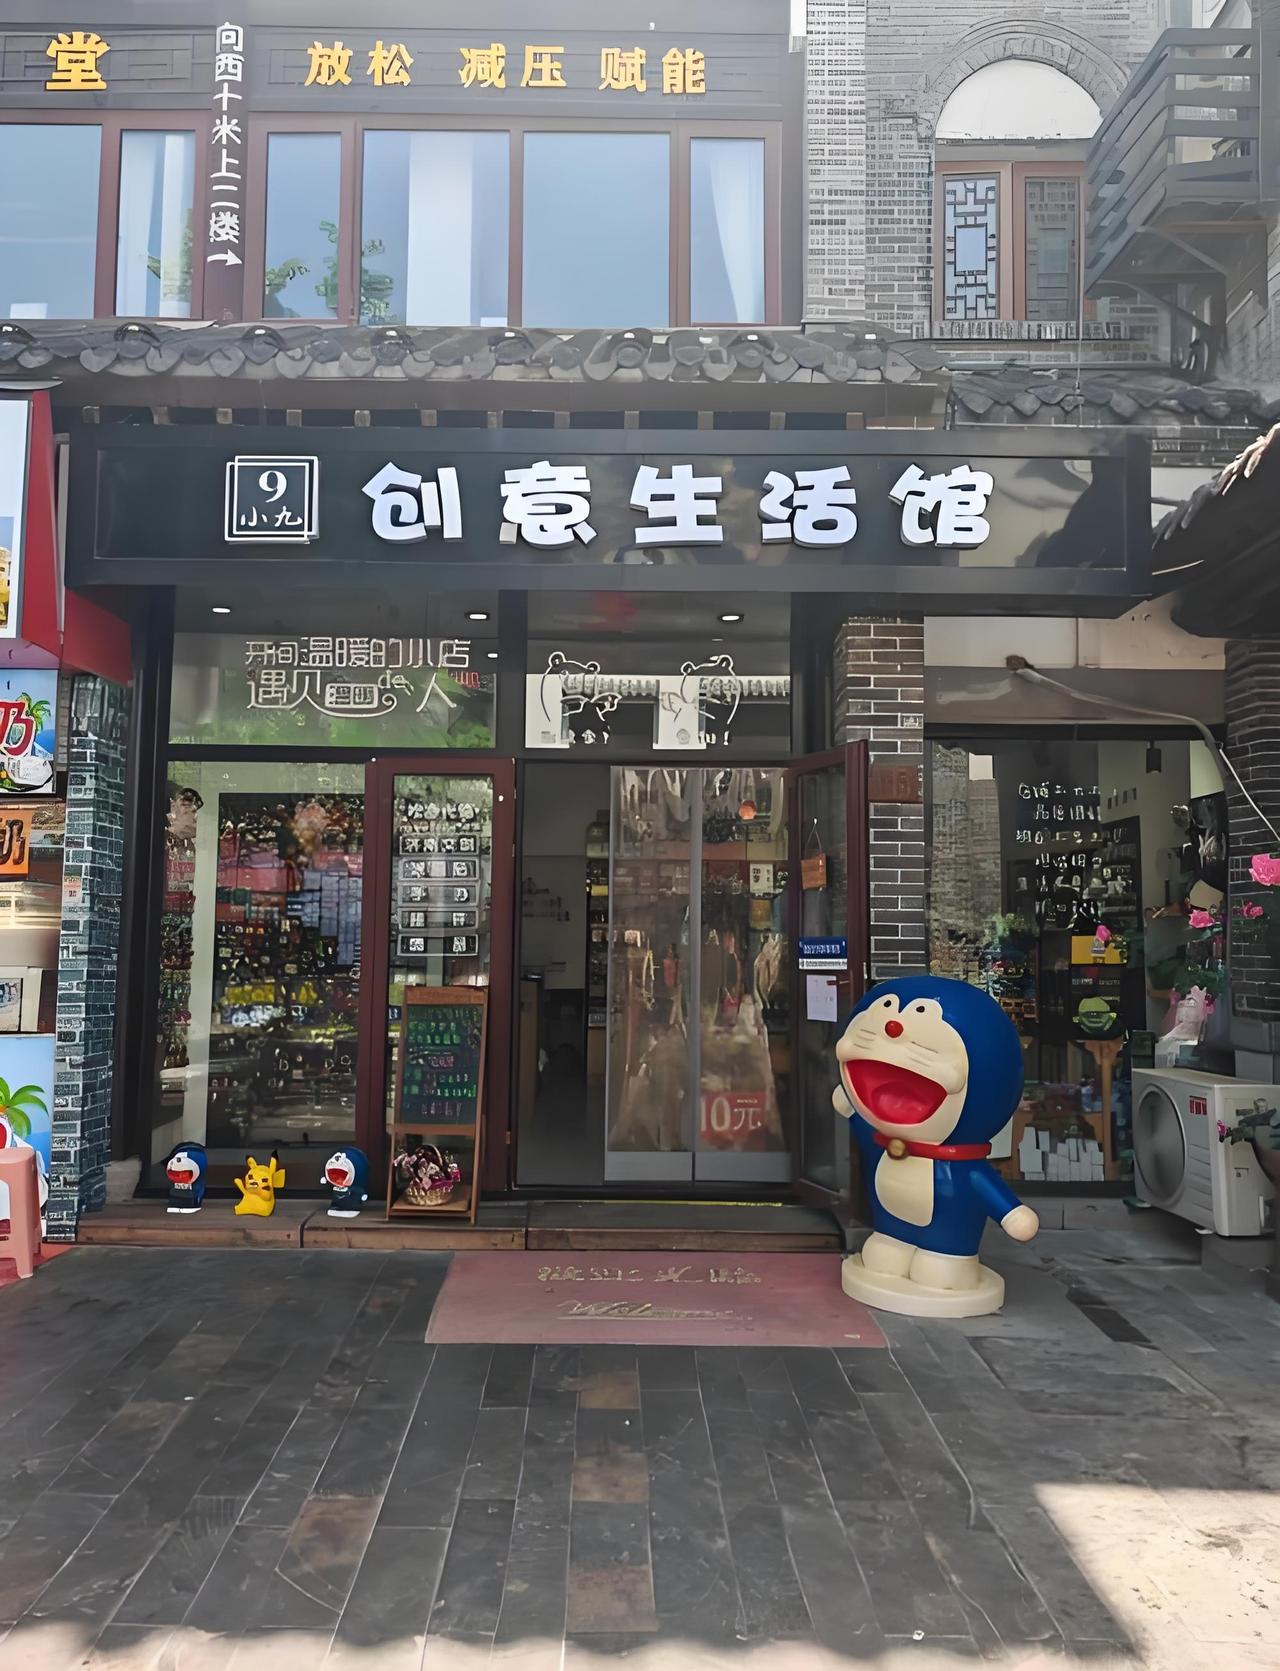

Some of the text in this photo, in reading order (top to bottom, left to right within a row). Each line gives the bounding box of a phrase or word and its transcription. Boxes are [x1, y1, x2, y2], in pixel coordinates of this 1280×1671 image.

[46, 32, 111, 92] 堂
[305, 41, 708, 95] 放松 减压 赋能
[208, 22, 245, 244] 向西十米上二楼
[258, 470, 288, 503] 9
[362, 461, 995, 549] 创意生活馆
[240, 505, 303, 527] 小九
